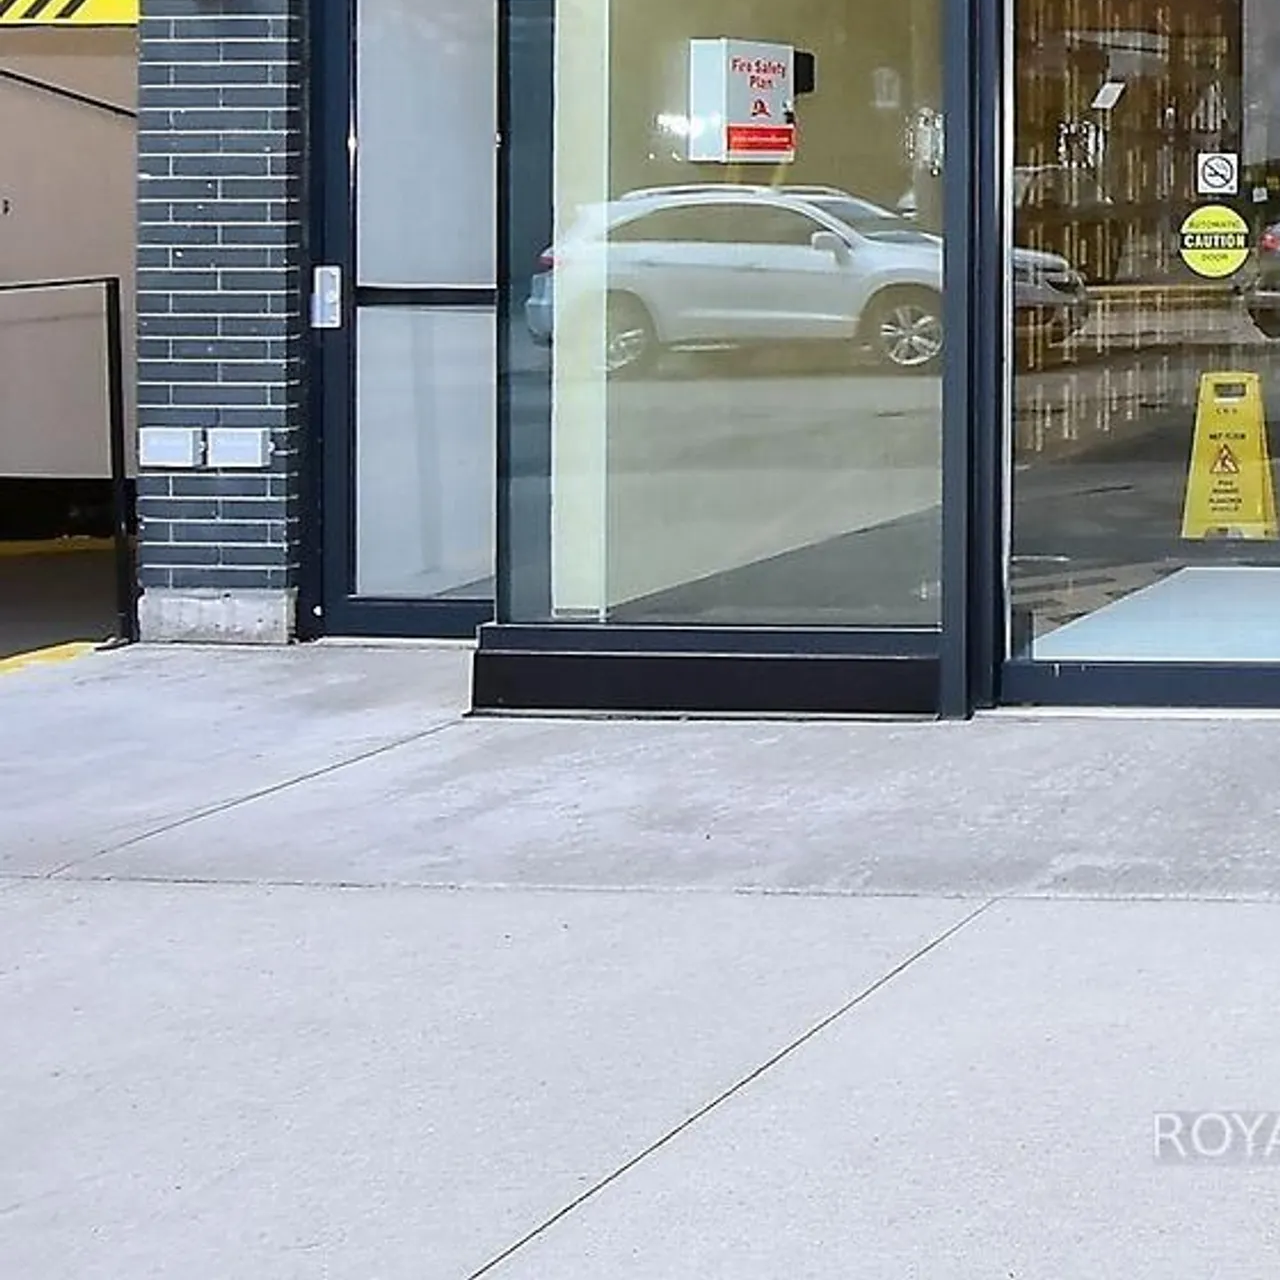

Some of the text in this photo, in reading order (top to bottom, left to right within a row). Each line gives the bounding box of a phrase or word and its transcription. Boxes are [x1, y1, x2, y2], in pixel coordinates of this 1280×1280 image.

[731, 58, 786, 78] Fire Safety
[749, 75, 773, 89] Plan
[1184, 234, 1246, 248] CAUTION
